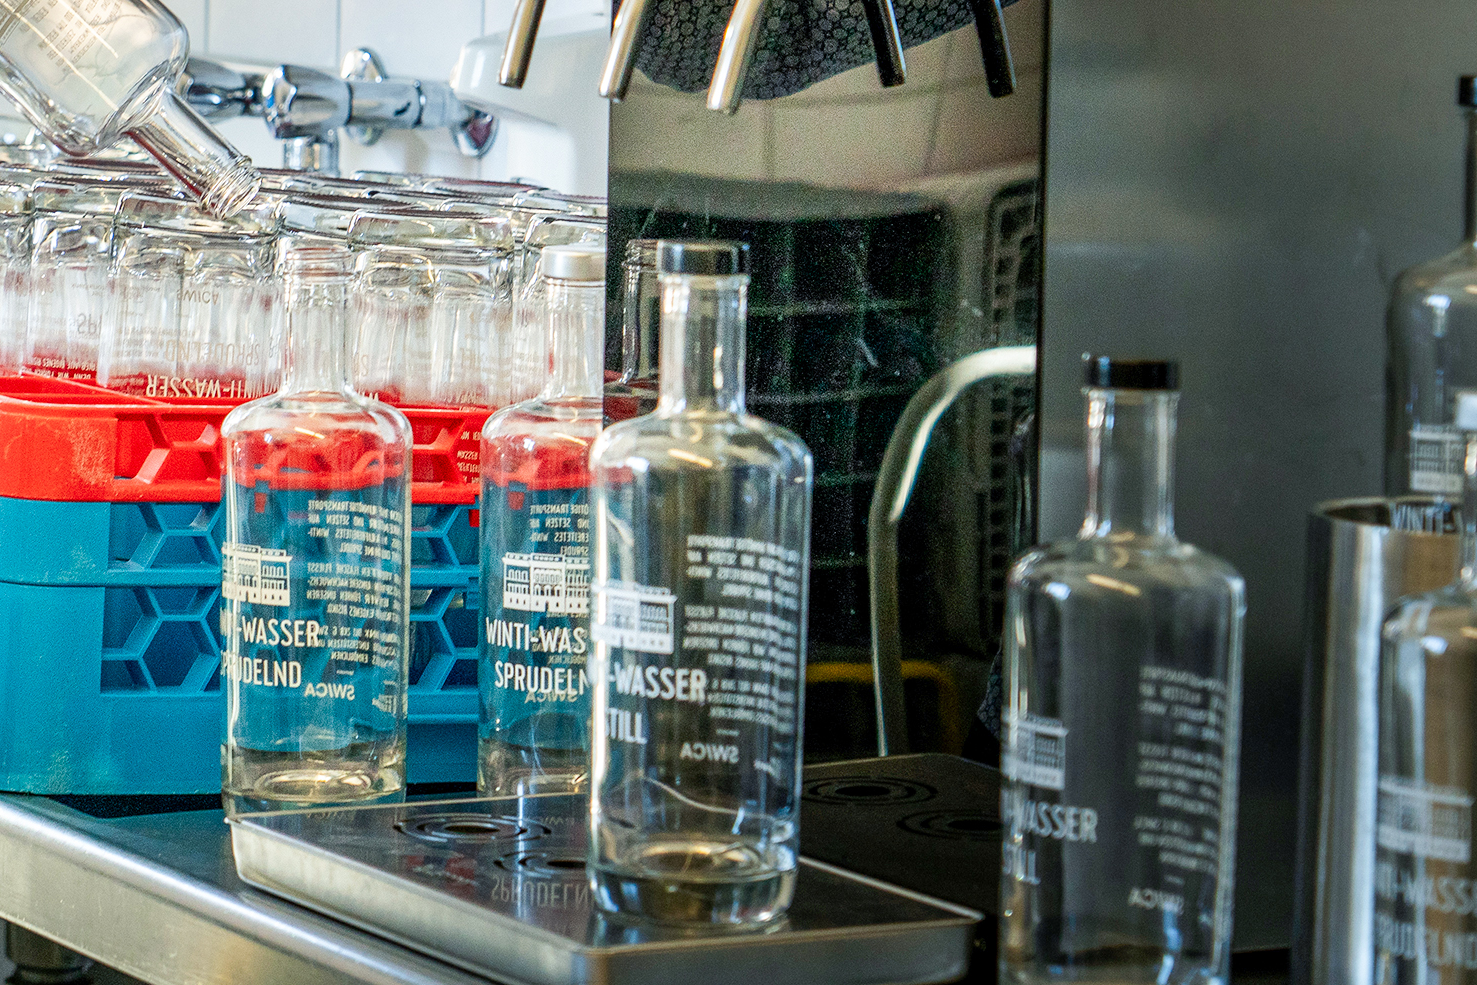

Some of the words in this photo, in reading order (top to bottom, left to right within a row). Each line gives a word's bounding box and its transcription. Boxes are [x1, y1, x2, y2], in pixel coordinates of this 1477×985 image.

[146, 374, 262, 399] NTI-WASSER
[221, 608, 320, 648] -WASSER
[485, 617, 586, 654] WINTI-WAS
[494, 660, 590, 696] SPRUDELN
[602, 661, 708, 703] -WASSER
